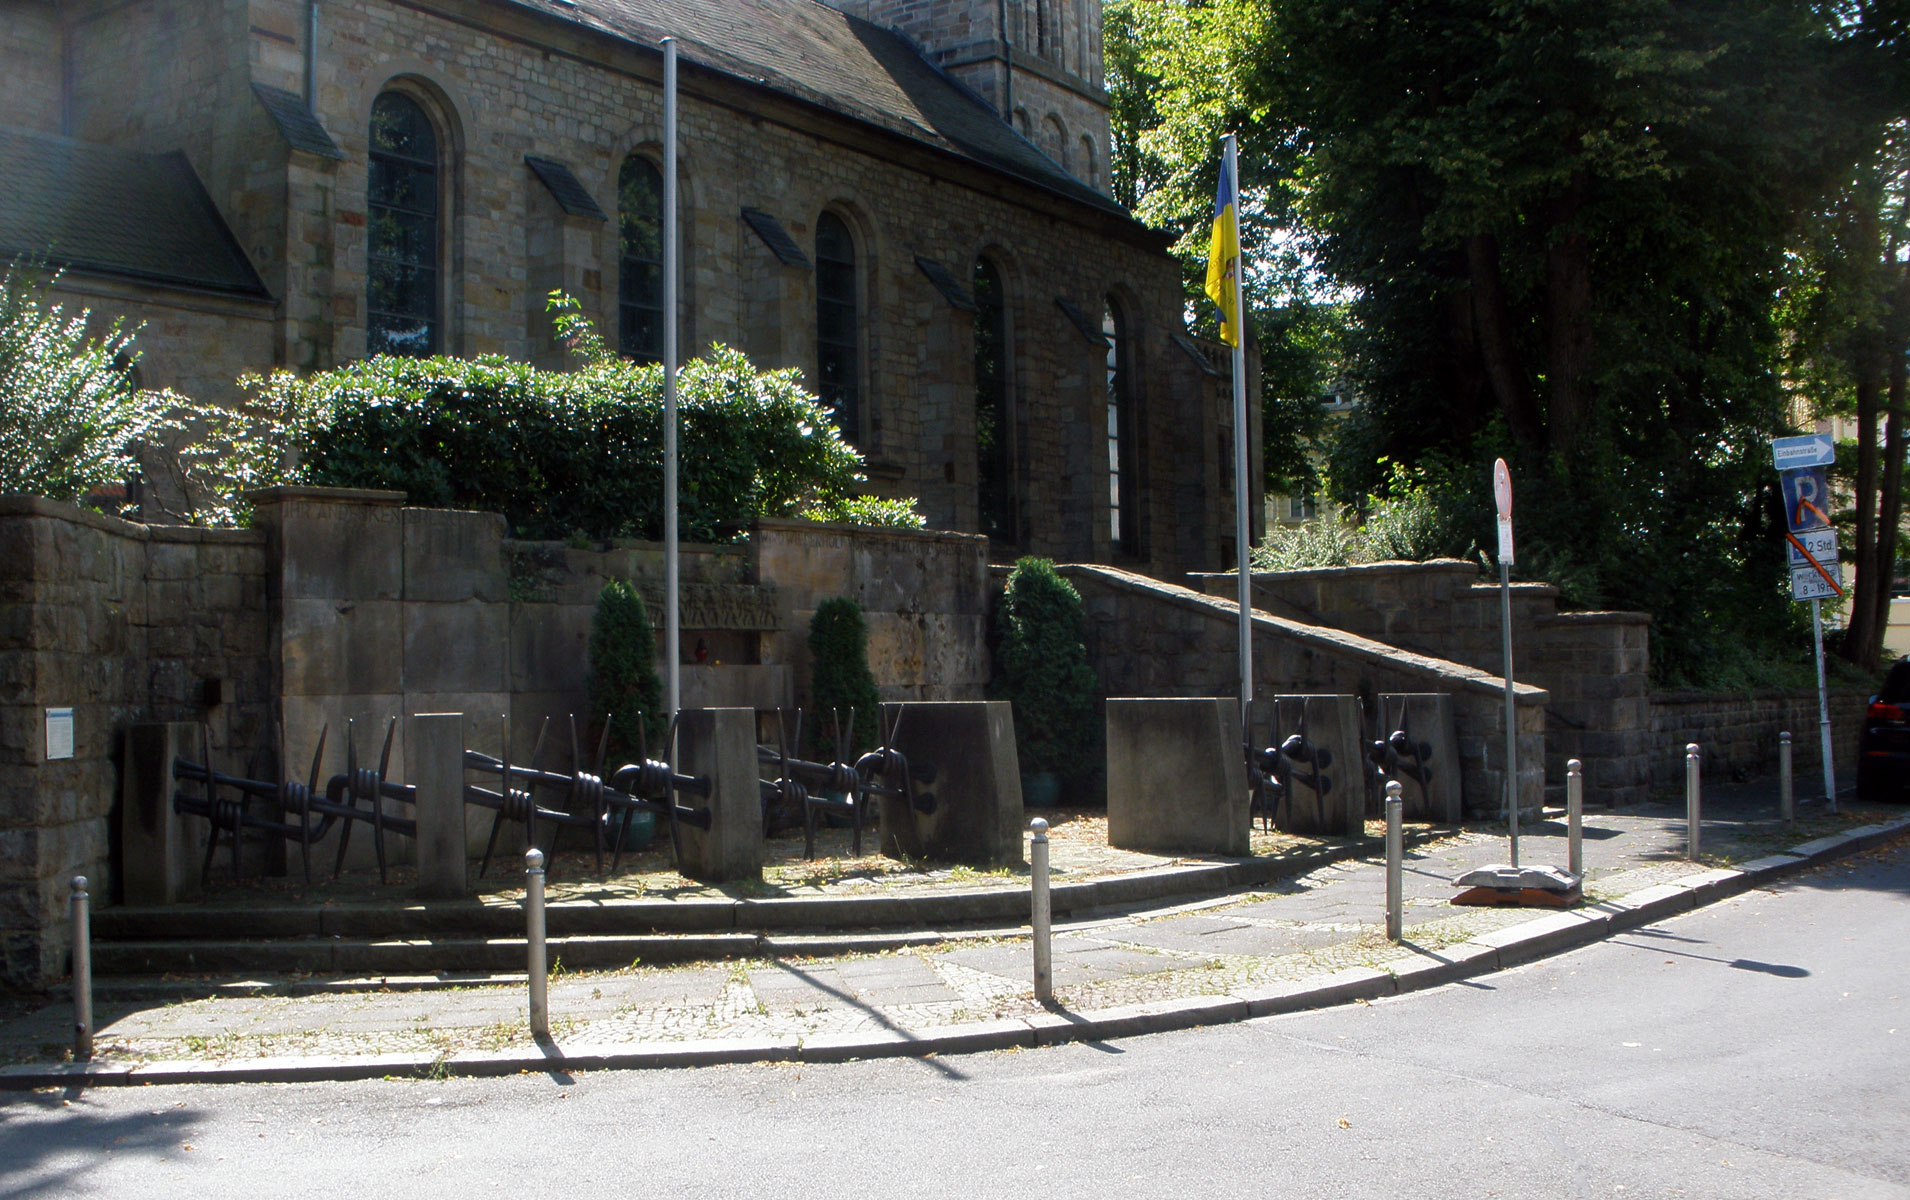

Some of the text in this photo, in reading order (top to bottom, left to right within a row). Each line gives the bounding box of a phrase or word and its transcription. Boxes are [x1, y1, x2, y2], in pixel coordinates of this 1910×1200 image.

[1777, 446, 1818, 458] Einbahnstraße
[1808, 540, 1834, 553] 2 Std.
